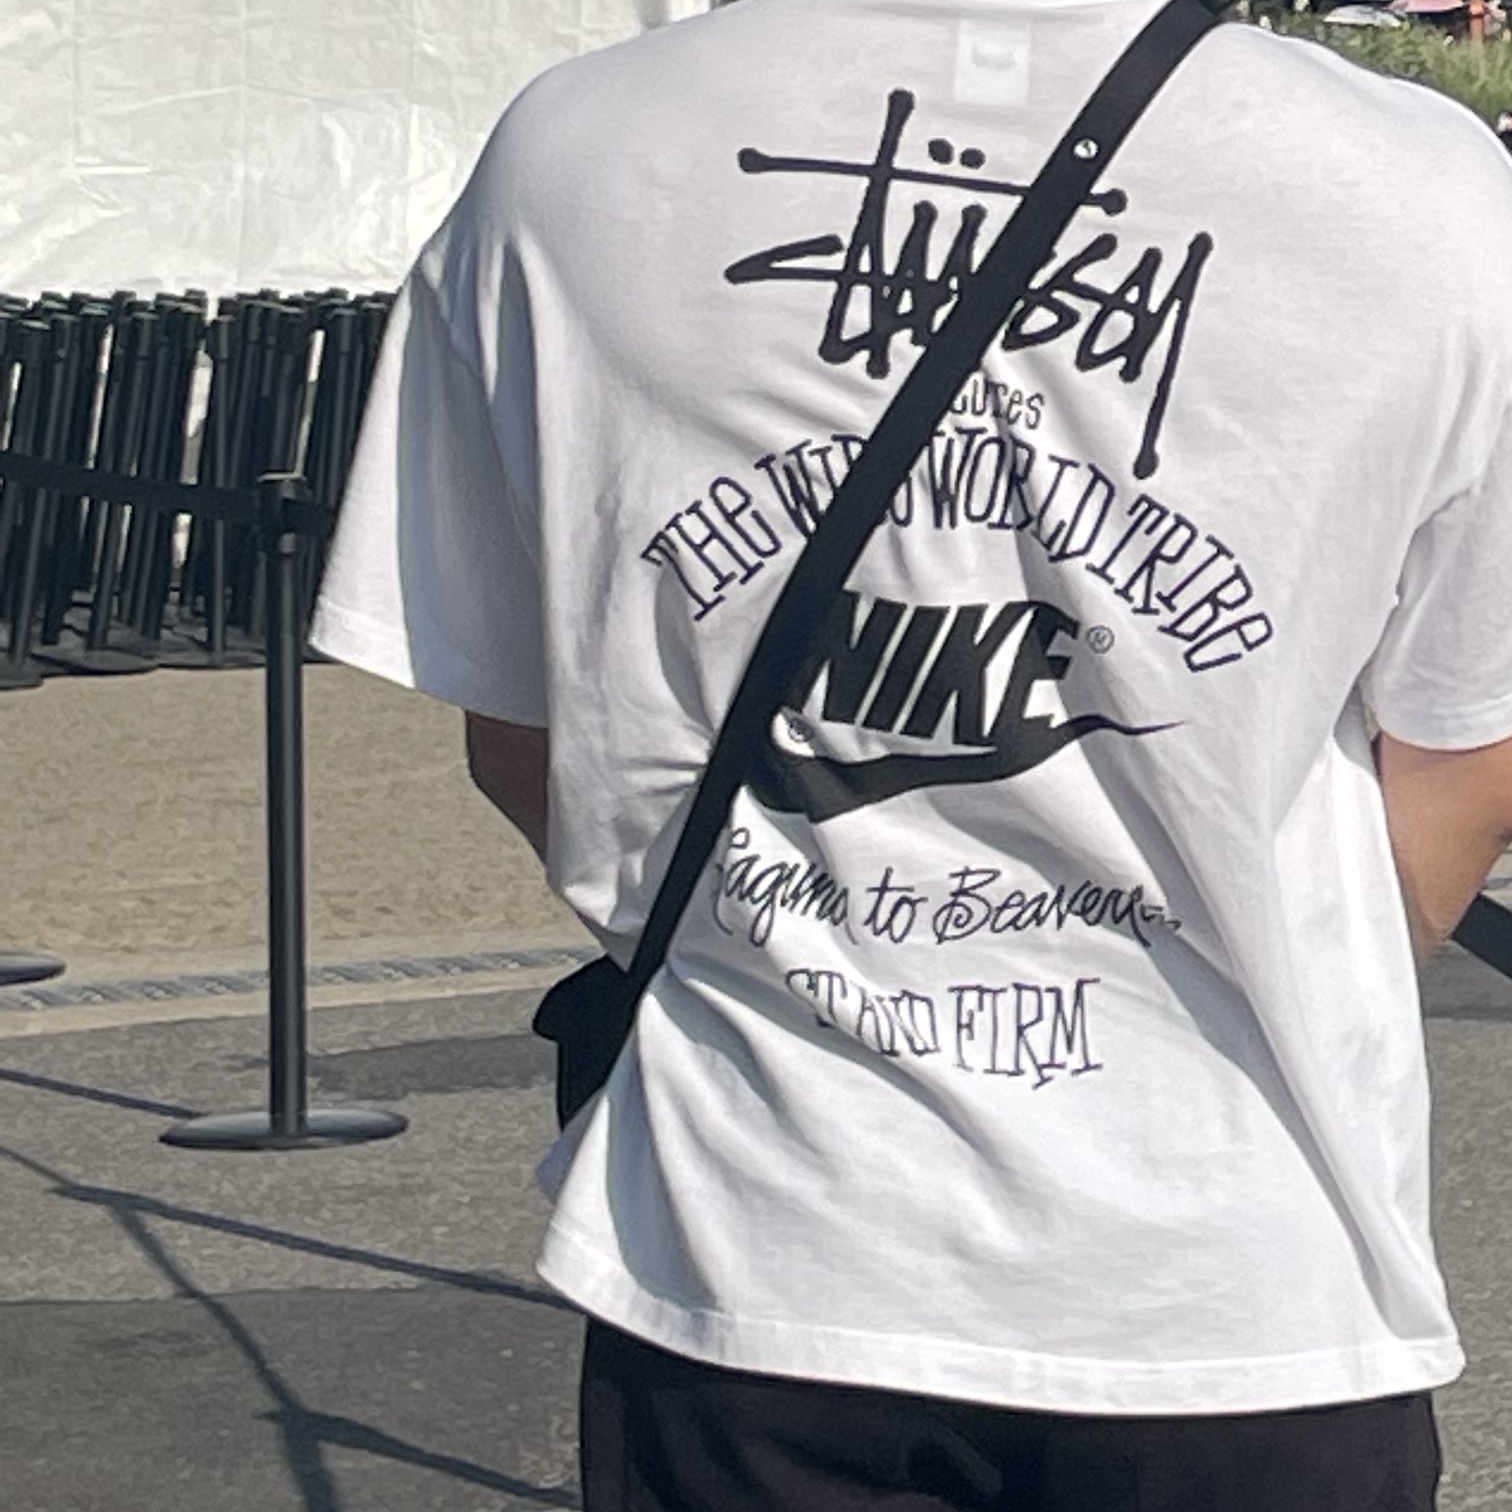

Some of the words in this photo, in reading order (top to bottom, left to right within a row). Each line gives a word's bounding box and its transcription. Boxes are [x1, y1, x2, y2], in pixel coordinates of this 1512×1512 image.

[929, 426, 1116, 564] WORLD
[783, 588, 1081, 747] NIKE
[863, 865, 929, 945] to
[947, 976, 1104, 1091] FIRM
